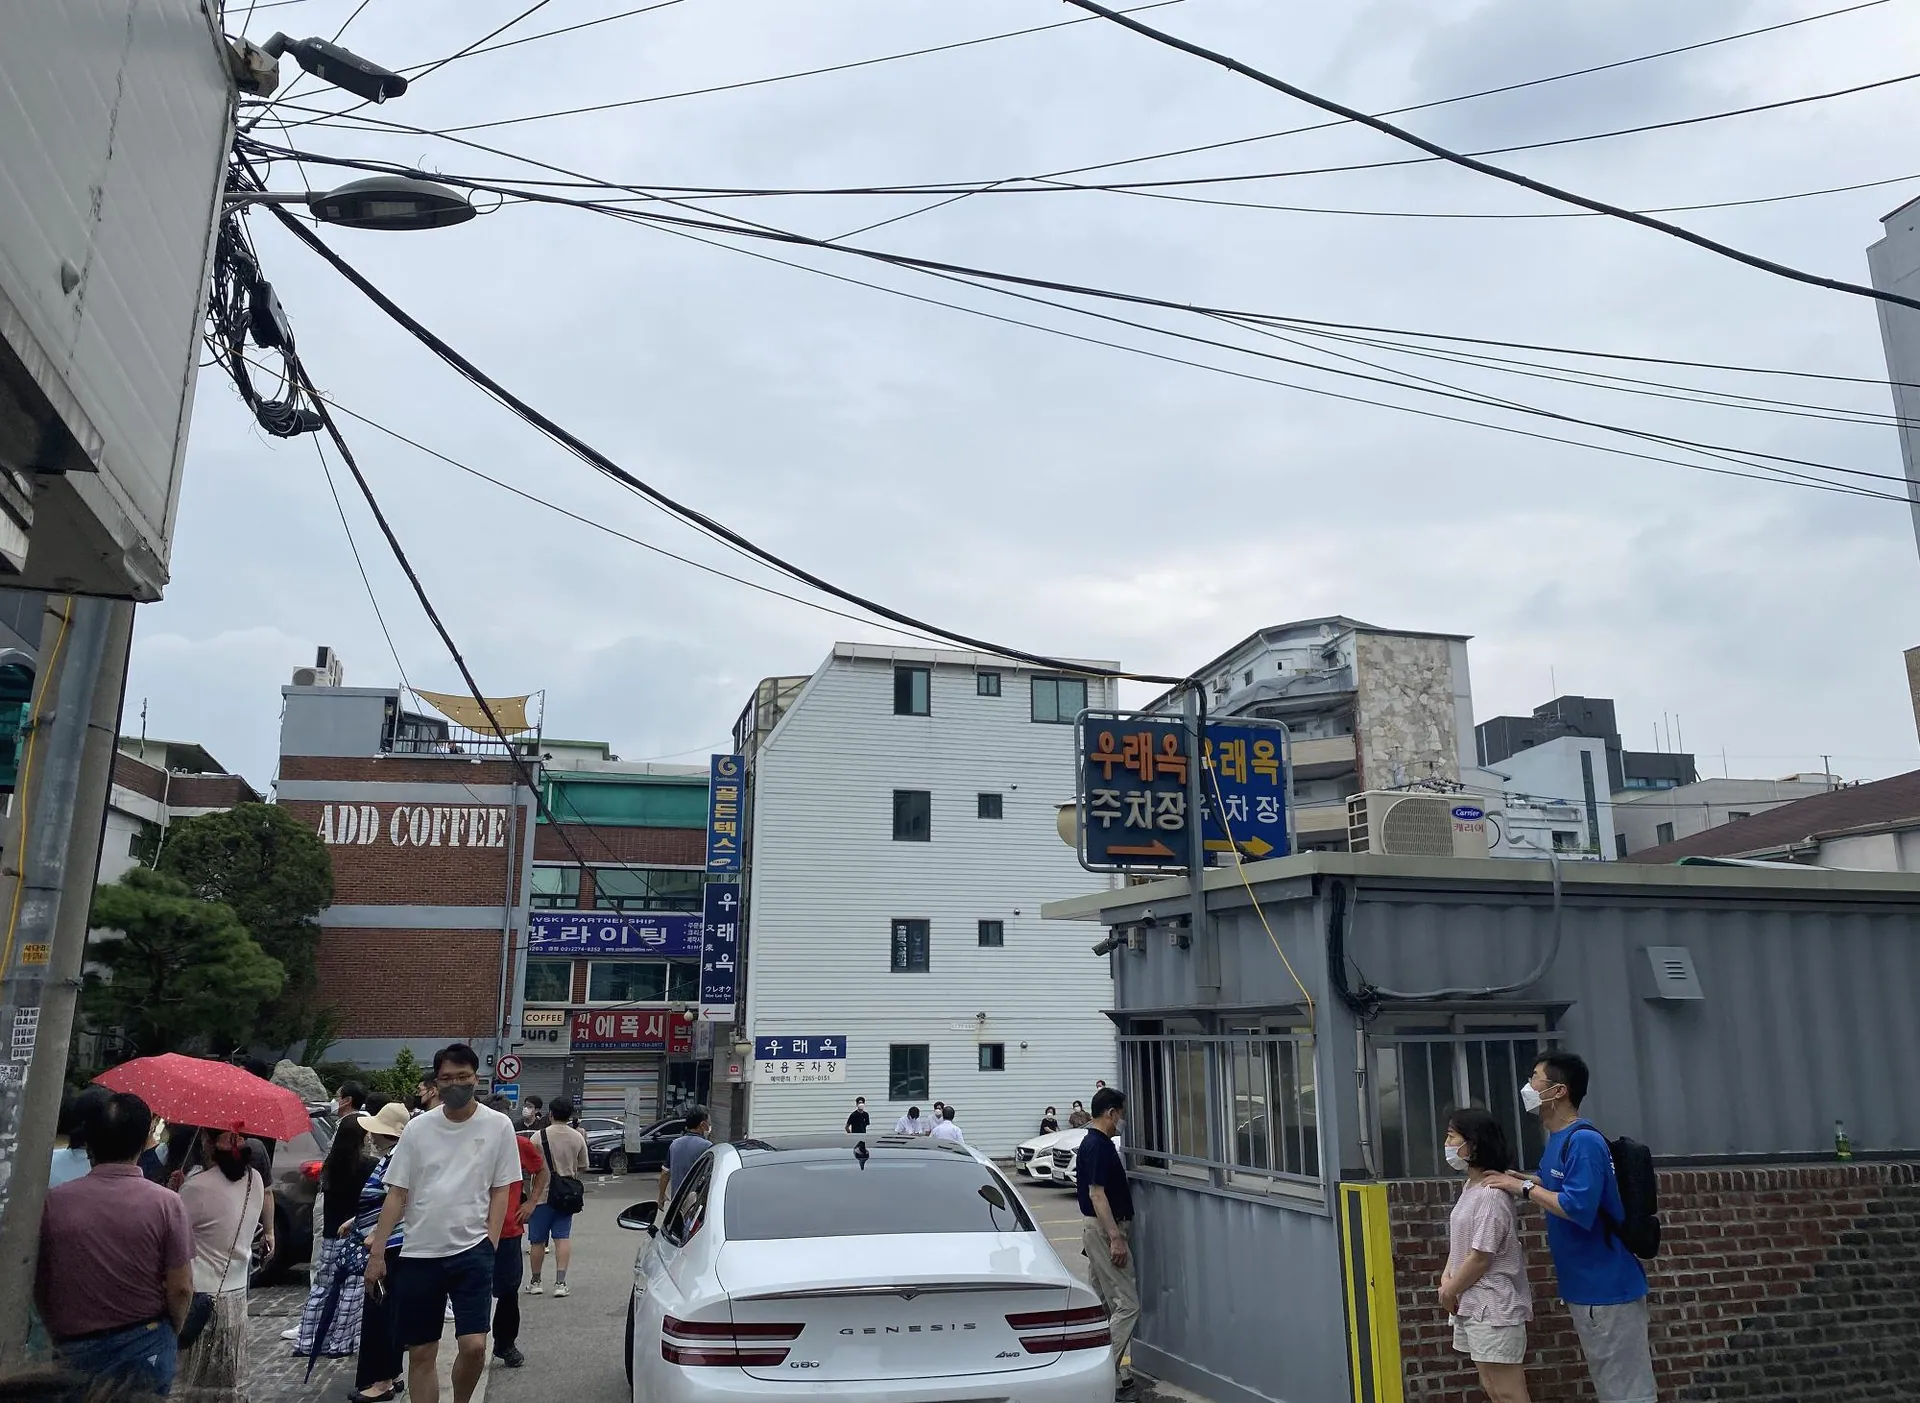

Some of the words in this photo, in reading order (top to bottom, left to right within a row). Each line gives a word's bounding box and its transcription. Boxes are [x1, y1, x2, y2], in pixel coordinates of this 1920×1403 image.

[1090, 731, 1188, 785] 우래옥
[1090, 788, 1187, 831] 주차장
[1455, 809, 1481, 817] Carrier
[317, 805, 380, 845] ADD
[390, 806, 507, 847] COFFEE
[712, 785, 739, 854] 골든텍스
[1453, 823, 1484, 832] 캐리어
[715, 892, 737, 973] 우래옥
[705, 985, 732, 993] ウレオク
[525, 1014, 563, 1022] COFFEE
[595, 1015, 664, 1038] 에폭시
[764, 1038, 838, 1057] 우래옥
[839, 1322, 976, 1335] GENESIS
[790, 1360, 820, 1369] G80
